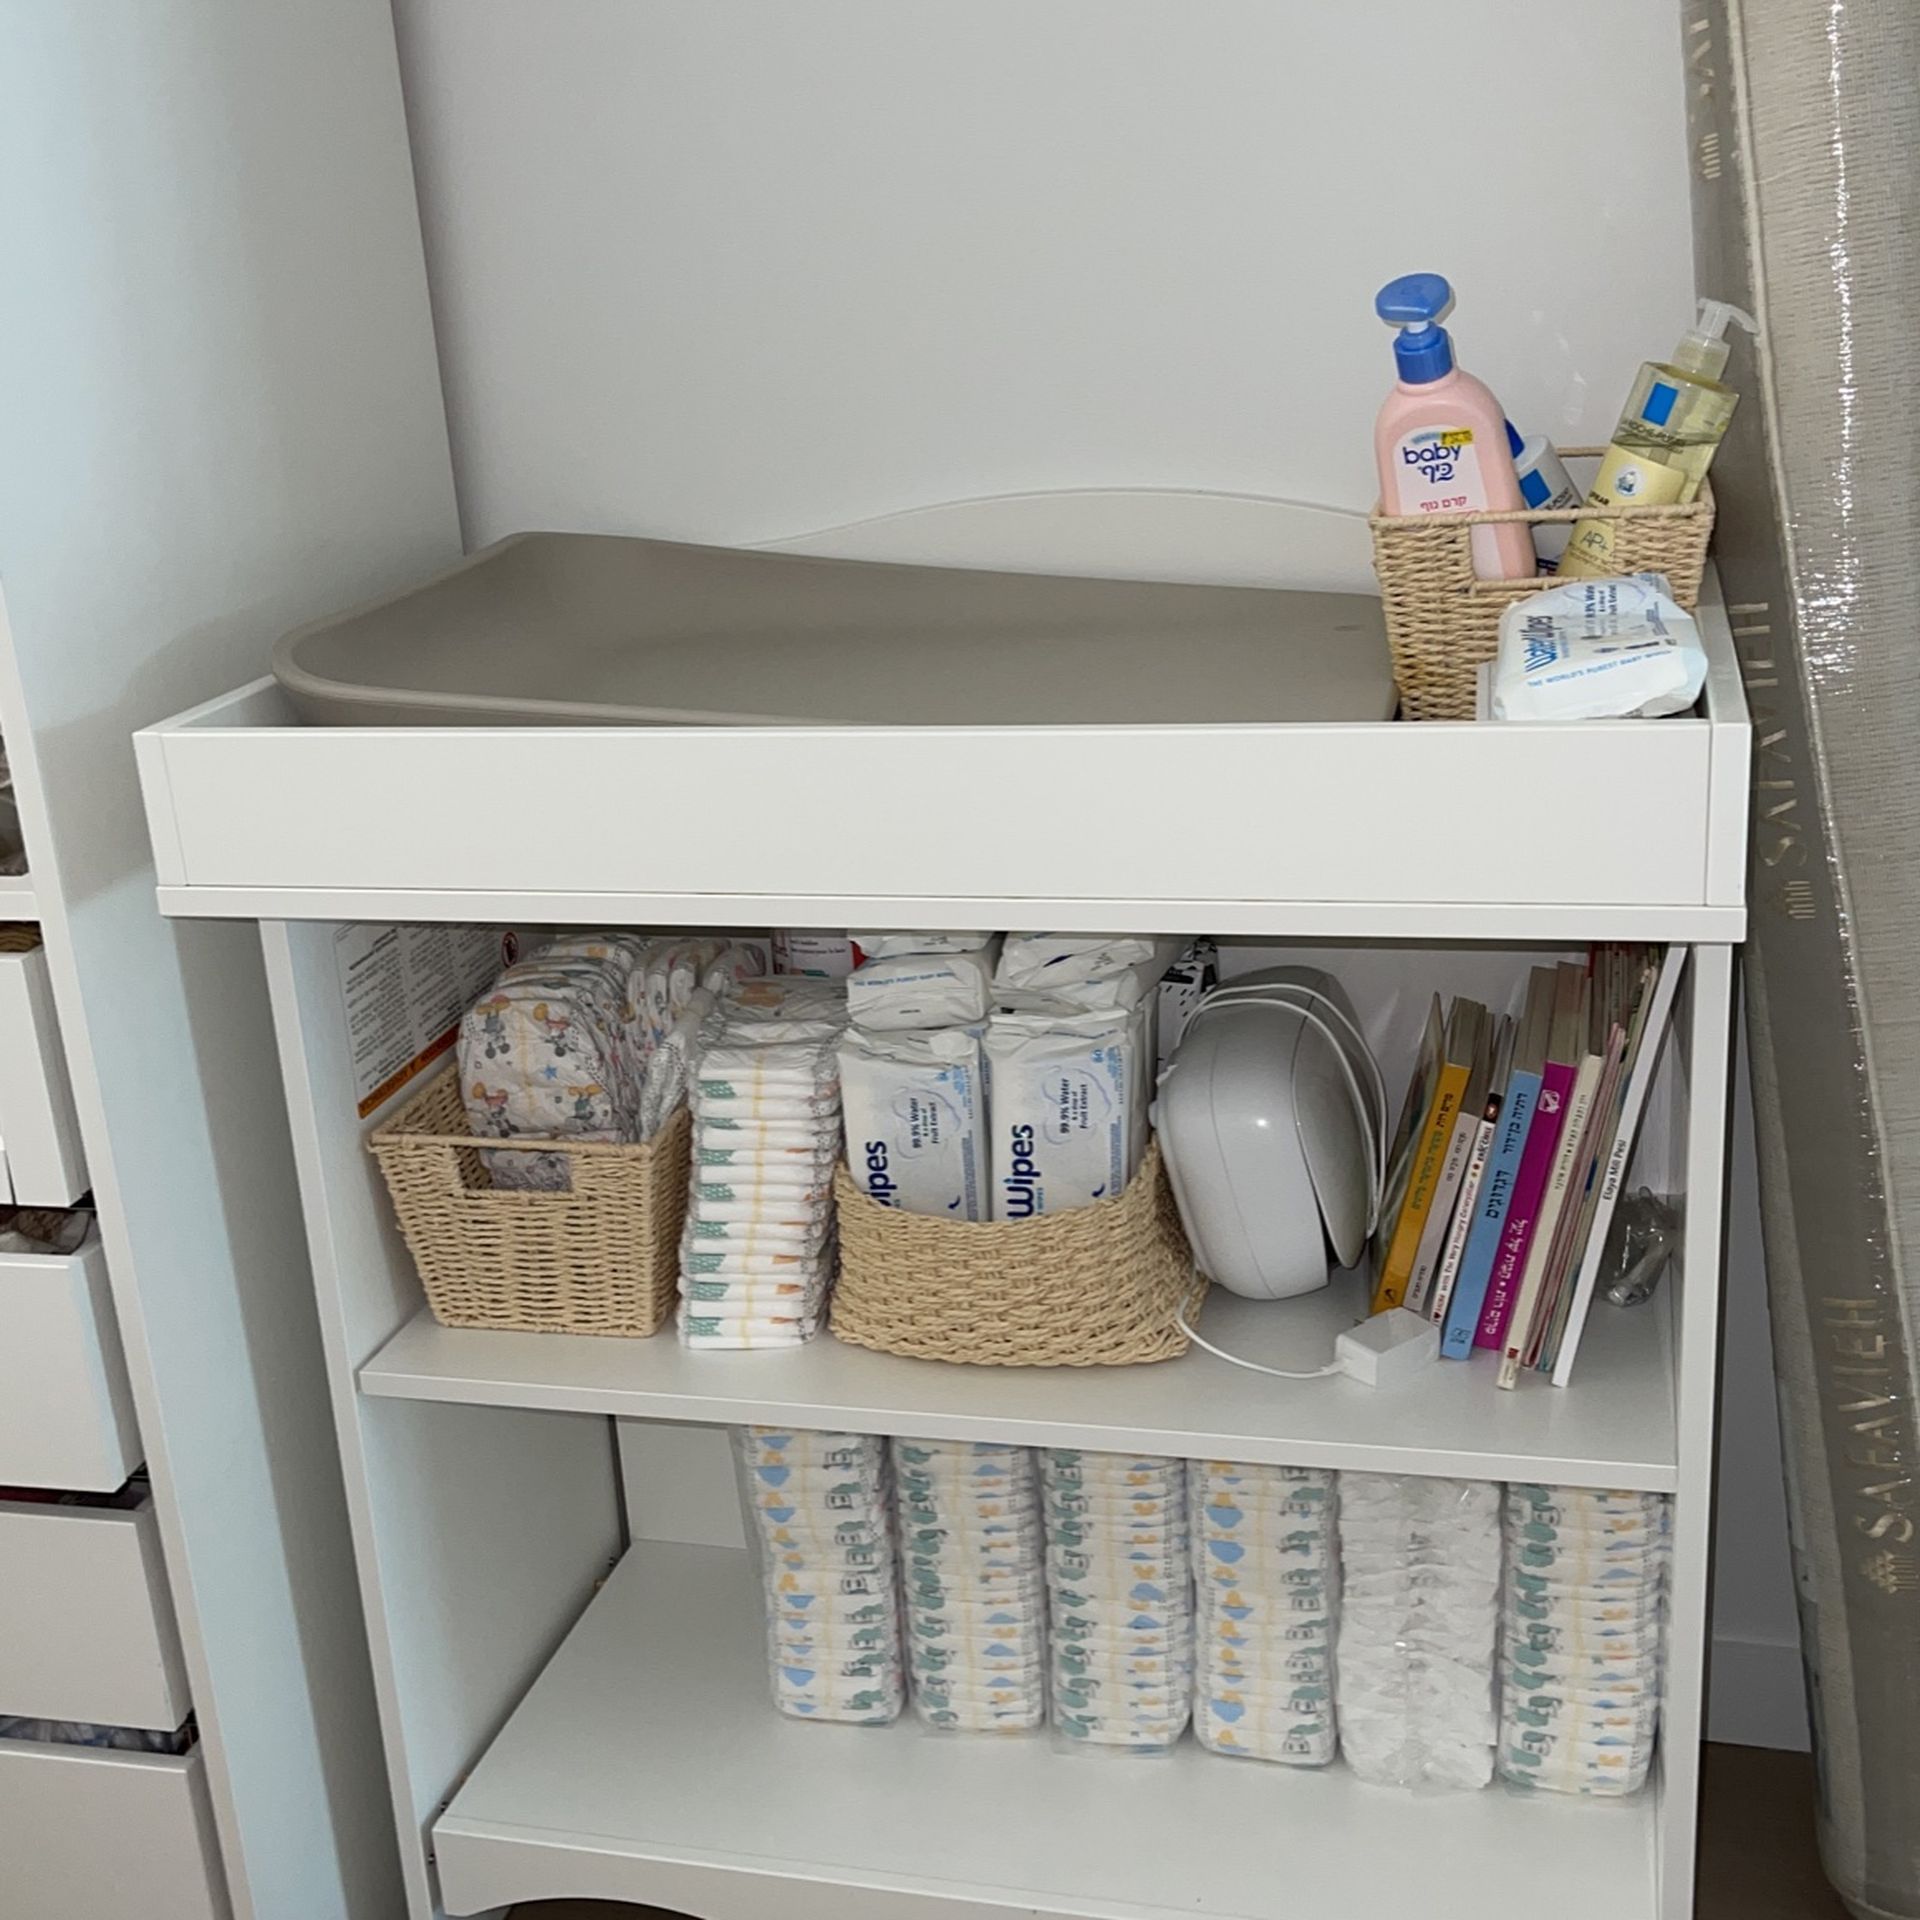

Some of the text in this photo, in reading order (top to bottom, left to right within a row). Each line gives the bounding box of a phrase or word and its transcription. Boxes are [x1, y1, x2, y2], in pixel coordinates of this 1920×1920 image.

[1402, 442, 1462, 466] baby
[1442, 496, 1467, 509] קרם
[1580, 531, 1608, 551] AP+
[909, 1098, 920, 1122] Water
[1060, 1078, 1070, 1134] 99.9% Water
[1078, 1084, 1088, 1129] Fruit Extract
[930, 1102, 940, 1144] Fruit Extract
[1821, 1297, 1914, 1543] SAFAVIEH
